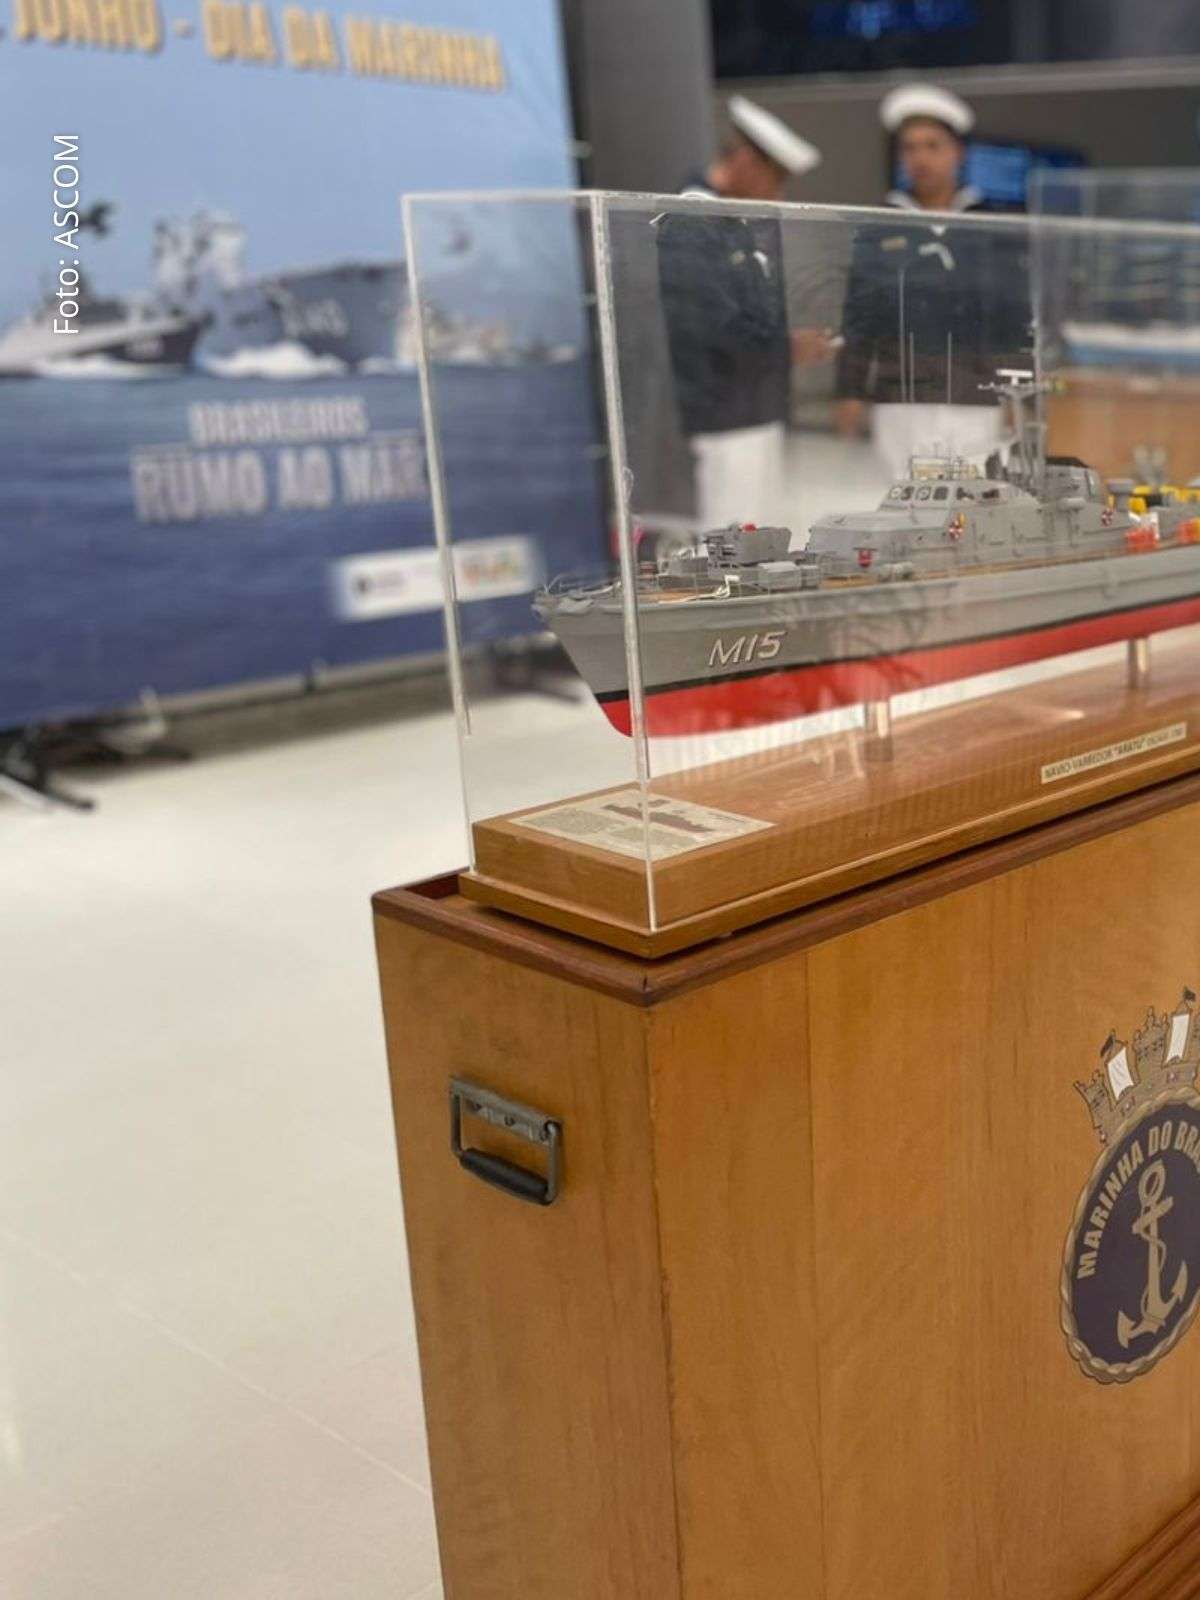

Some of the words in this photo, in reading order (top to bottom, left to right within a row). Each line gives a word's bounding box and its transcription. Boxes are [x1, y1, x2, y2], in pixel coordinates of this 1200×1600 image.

[13, 0, 162, 52] JUNHO
[204, 2, 275, 63] DIA
[282, 8, 340, 69] DA
[346, 14, 506, 90] MARINHA
[134, 449, 267, 522] RUMO
[277, 445, 332, 510] AO
[707, 630, 789, 667] M15
[1076, 1140, 1145, 1280] MARINHA
[1148, 1119, 1173, 1157] DO
